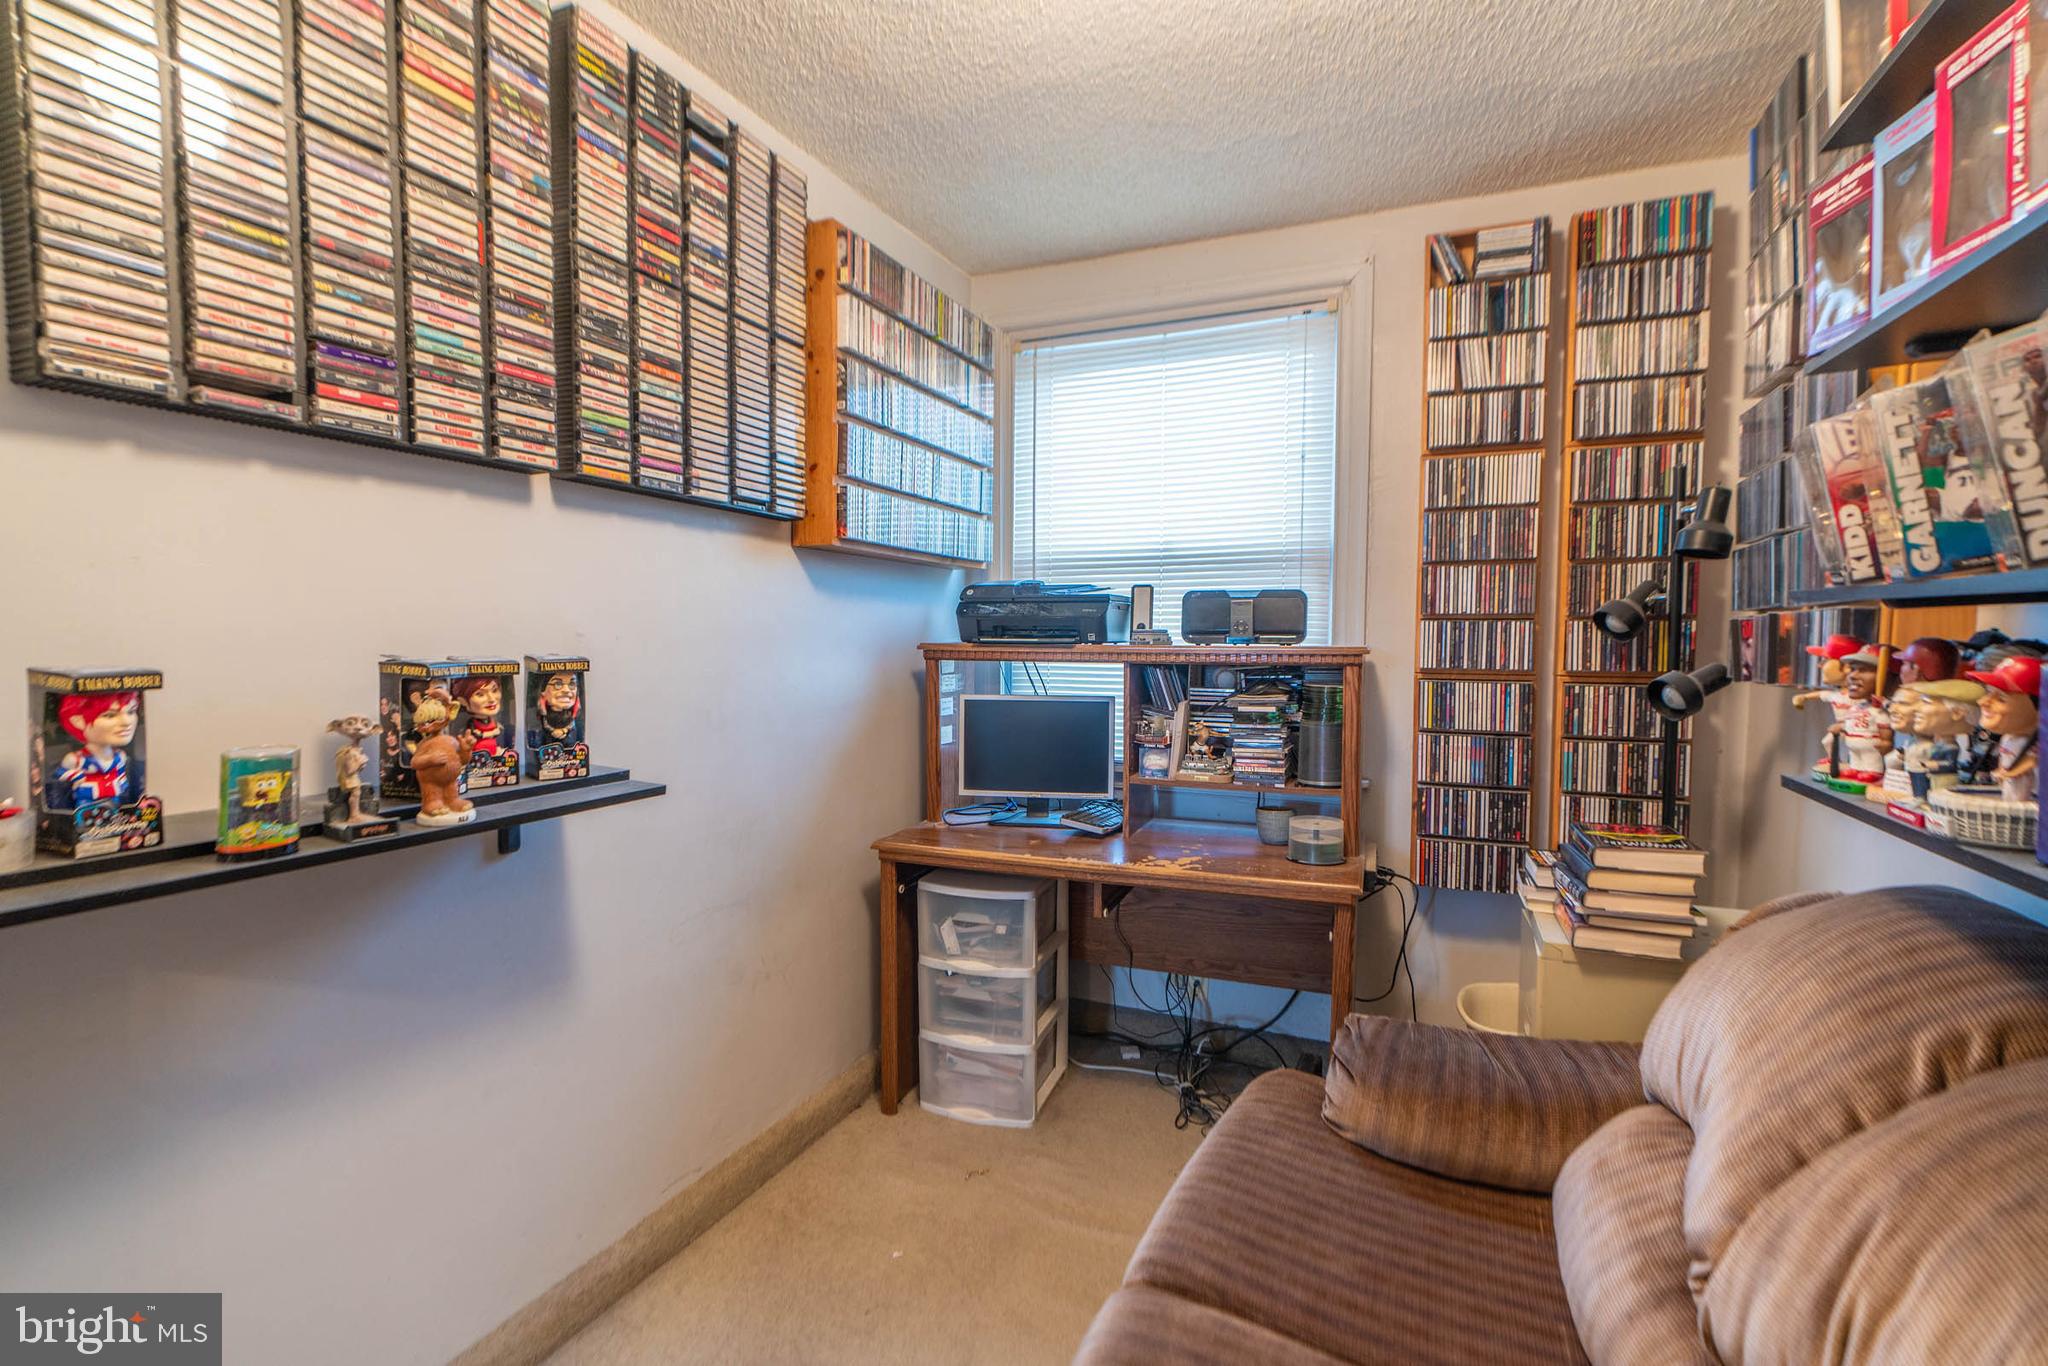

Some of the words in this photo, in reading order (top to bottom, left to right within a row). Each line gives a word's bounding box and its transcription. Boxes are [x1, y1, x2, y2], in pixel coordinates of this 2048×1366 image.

[2012, 105, 2026, 182] PLAYER
[1888, 411, 1943, 573] GARNETT
[1988, 383, 2048, 560] DUNCAN
[1838, 504, 1876, 580] KIDD
[494, 664, 519, 673] BOBBER
[540, 662, 565, 671] TALKING
[566, 661, 588, 670] BOBBER
